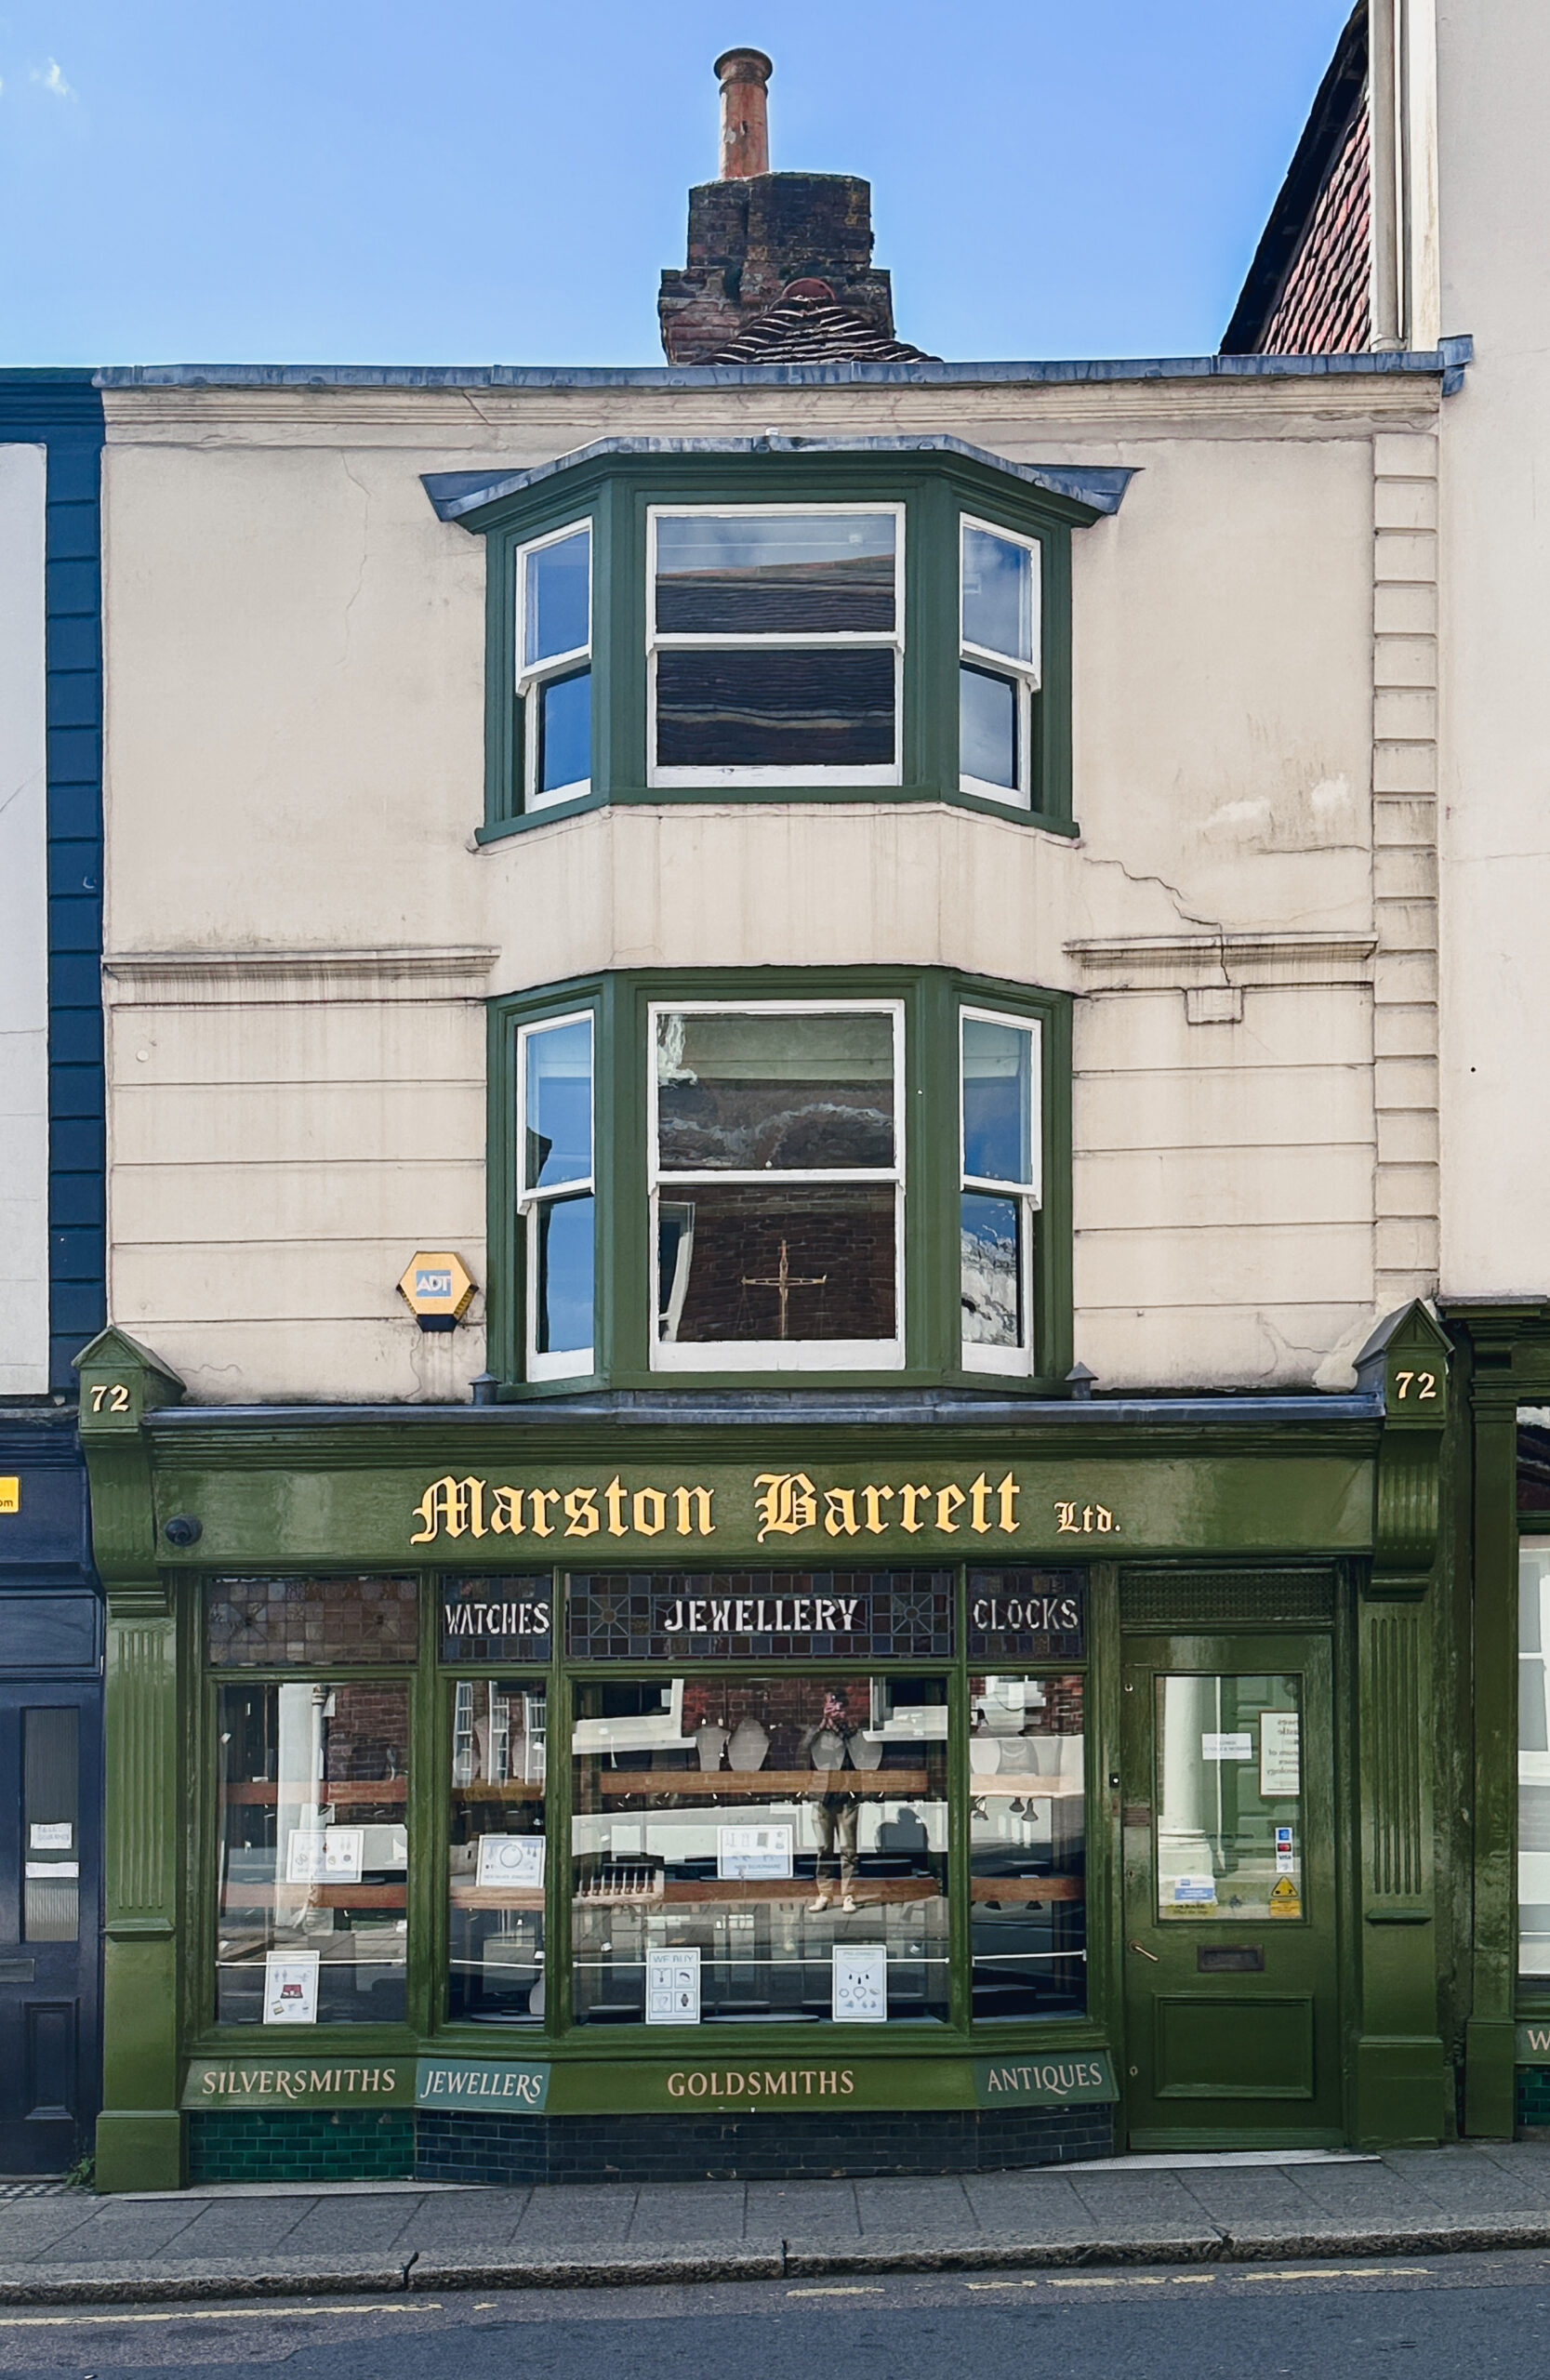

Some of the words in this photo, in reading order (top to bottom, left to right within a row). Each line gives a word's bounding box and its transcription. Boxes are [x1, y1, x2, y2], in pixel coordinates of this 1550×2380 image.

[416, 1275, 452, 1292] ADT
[89, 1383, 130, 1413] 72
[1395, 1371, 1437, 1400] 72
[410, 1474, 716, 1545] Marston
[753, 1471, 1021, 1543] Barrett
[1053, 1501, 1121, 1533] Ltd.
[444, 1603, 550, 1635] WATCHES
[664, 1599, 858, 1632] JEWELLERY
[973, 1598, 1079, 1630] CLOCKS
[202, 2069, 396, 2099] SILVERSMITHS
[420, 2070, 543, 2104] JEWELLERS
[667, 2070, 854, 2096] GOLDSMITHS
[987, 2063, 1103, 2096] ANTIQUES
